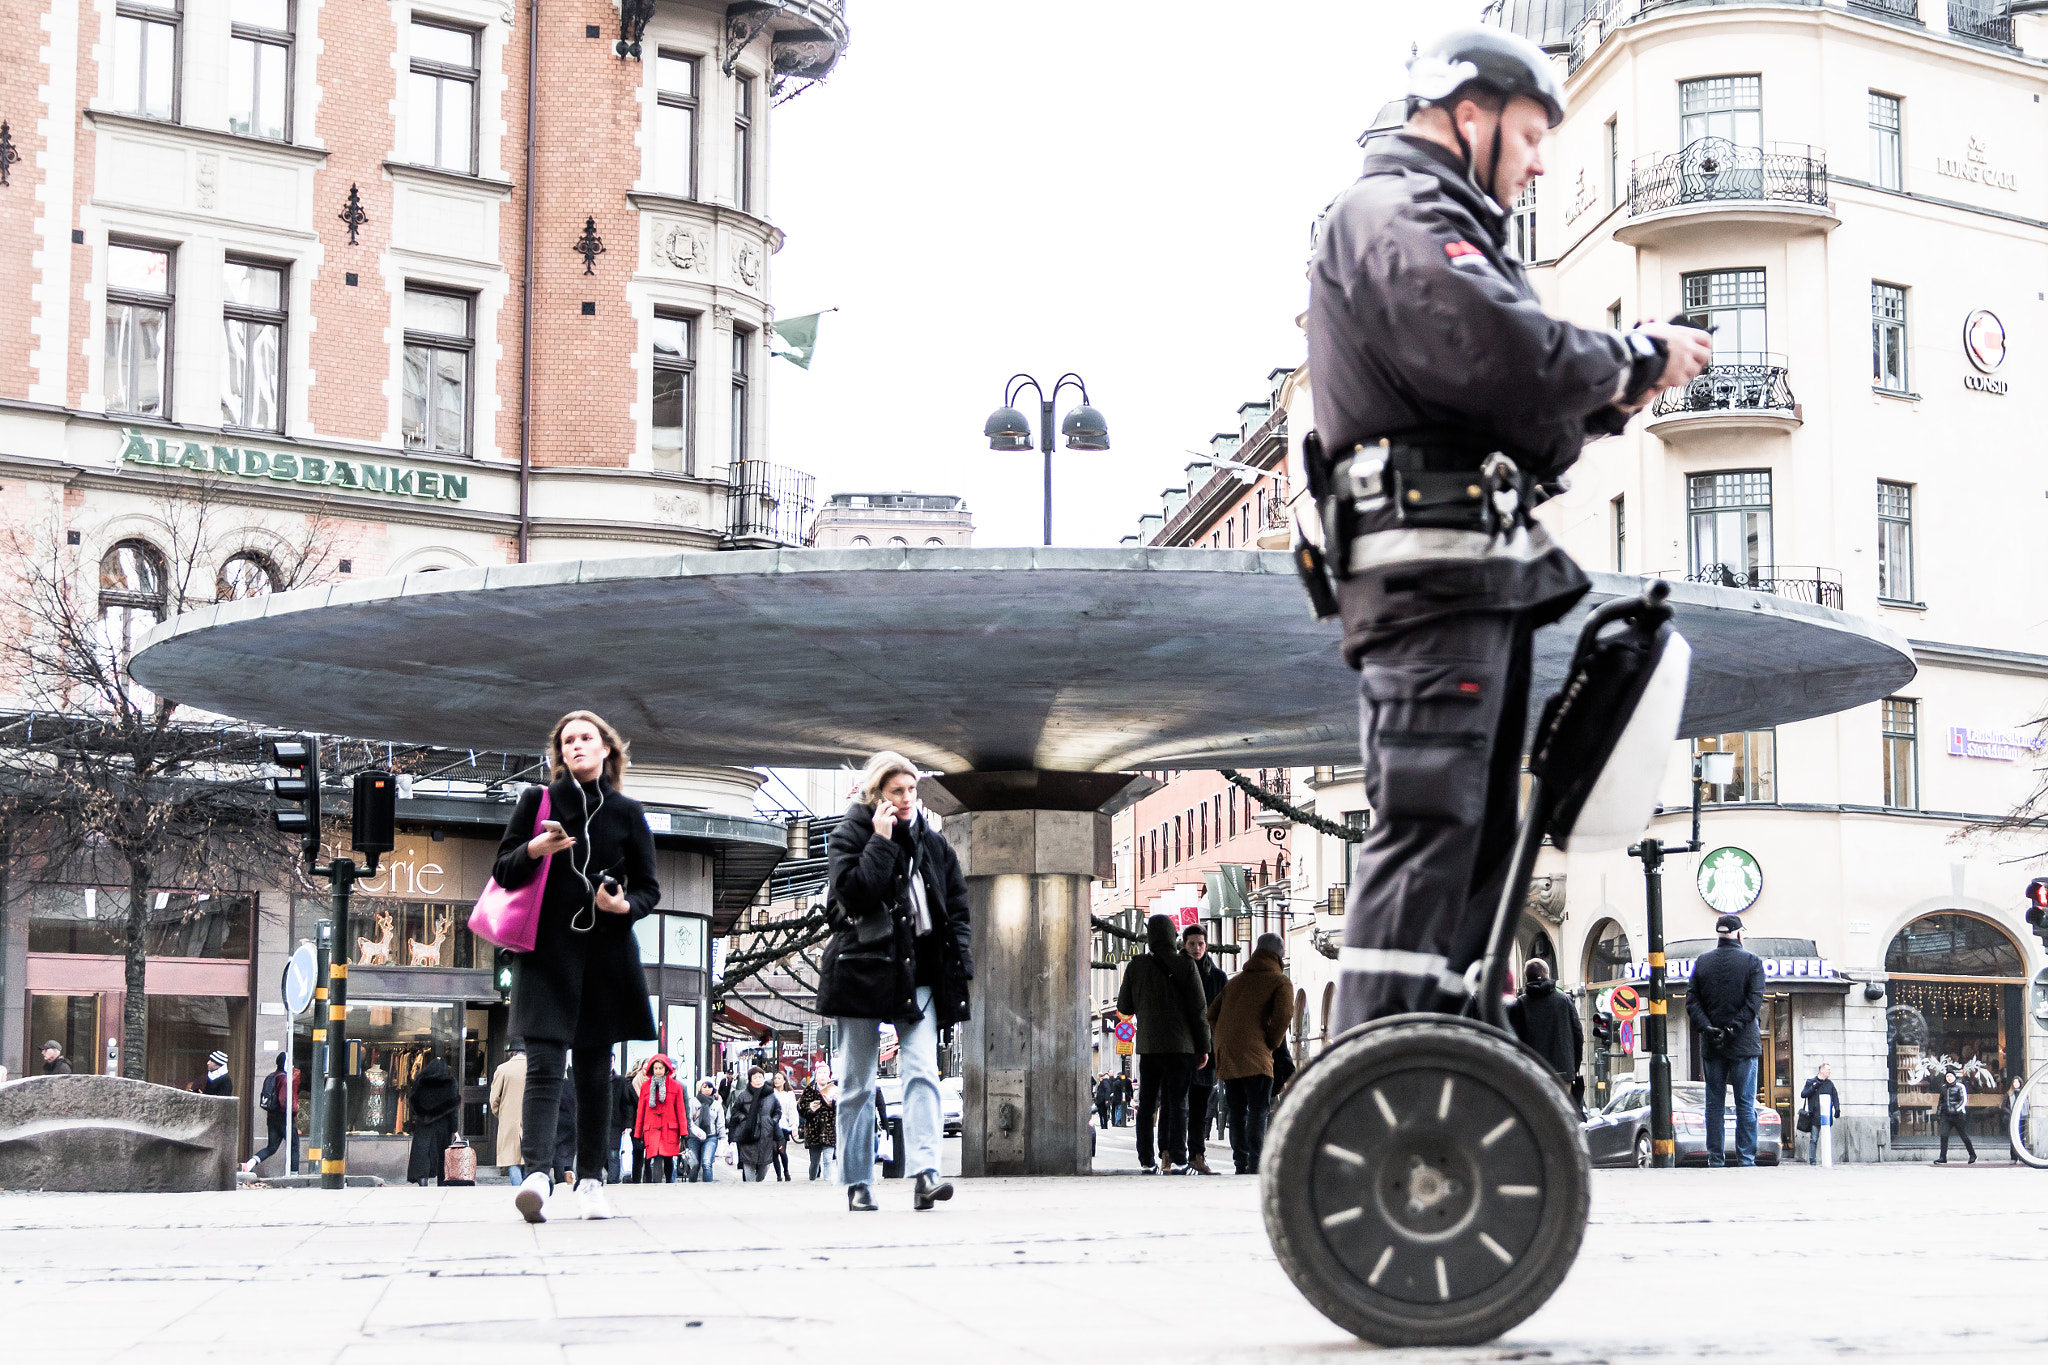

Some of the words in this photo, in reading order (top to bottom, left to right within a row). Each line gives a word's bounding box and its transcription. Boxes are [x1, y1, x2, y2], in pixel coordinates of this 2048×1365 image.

[1964, 375, 2008, 396] CONSID
[121, 427, 467, 500] ÅLANDSBANKEN
[1761, 958, 1834, 978] OFFEE
[782, 1041, 804, 1051] ÅTERV
[782, 1050, 804, 1058] JULEN
